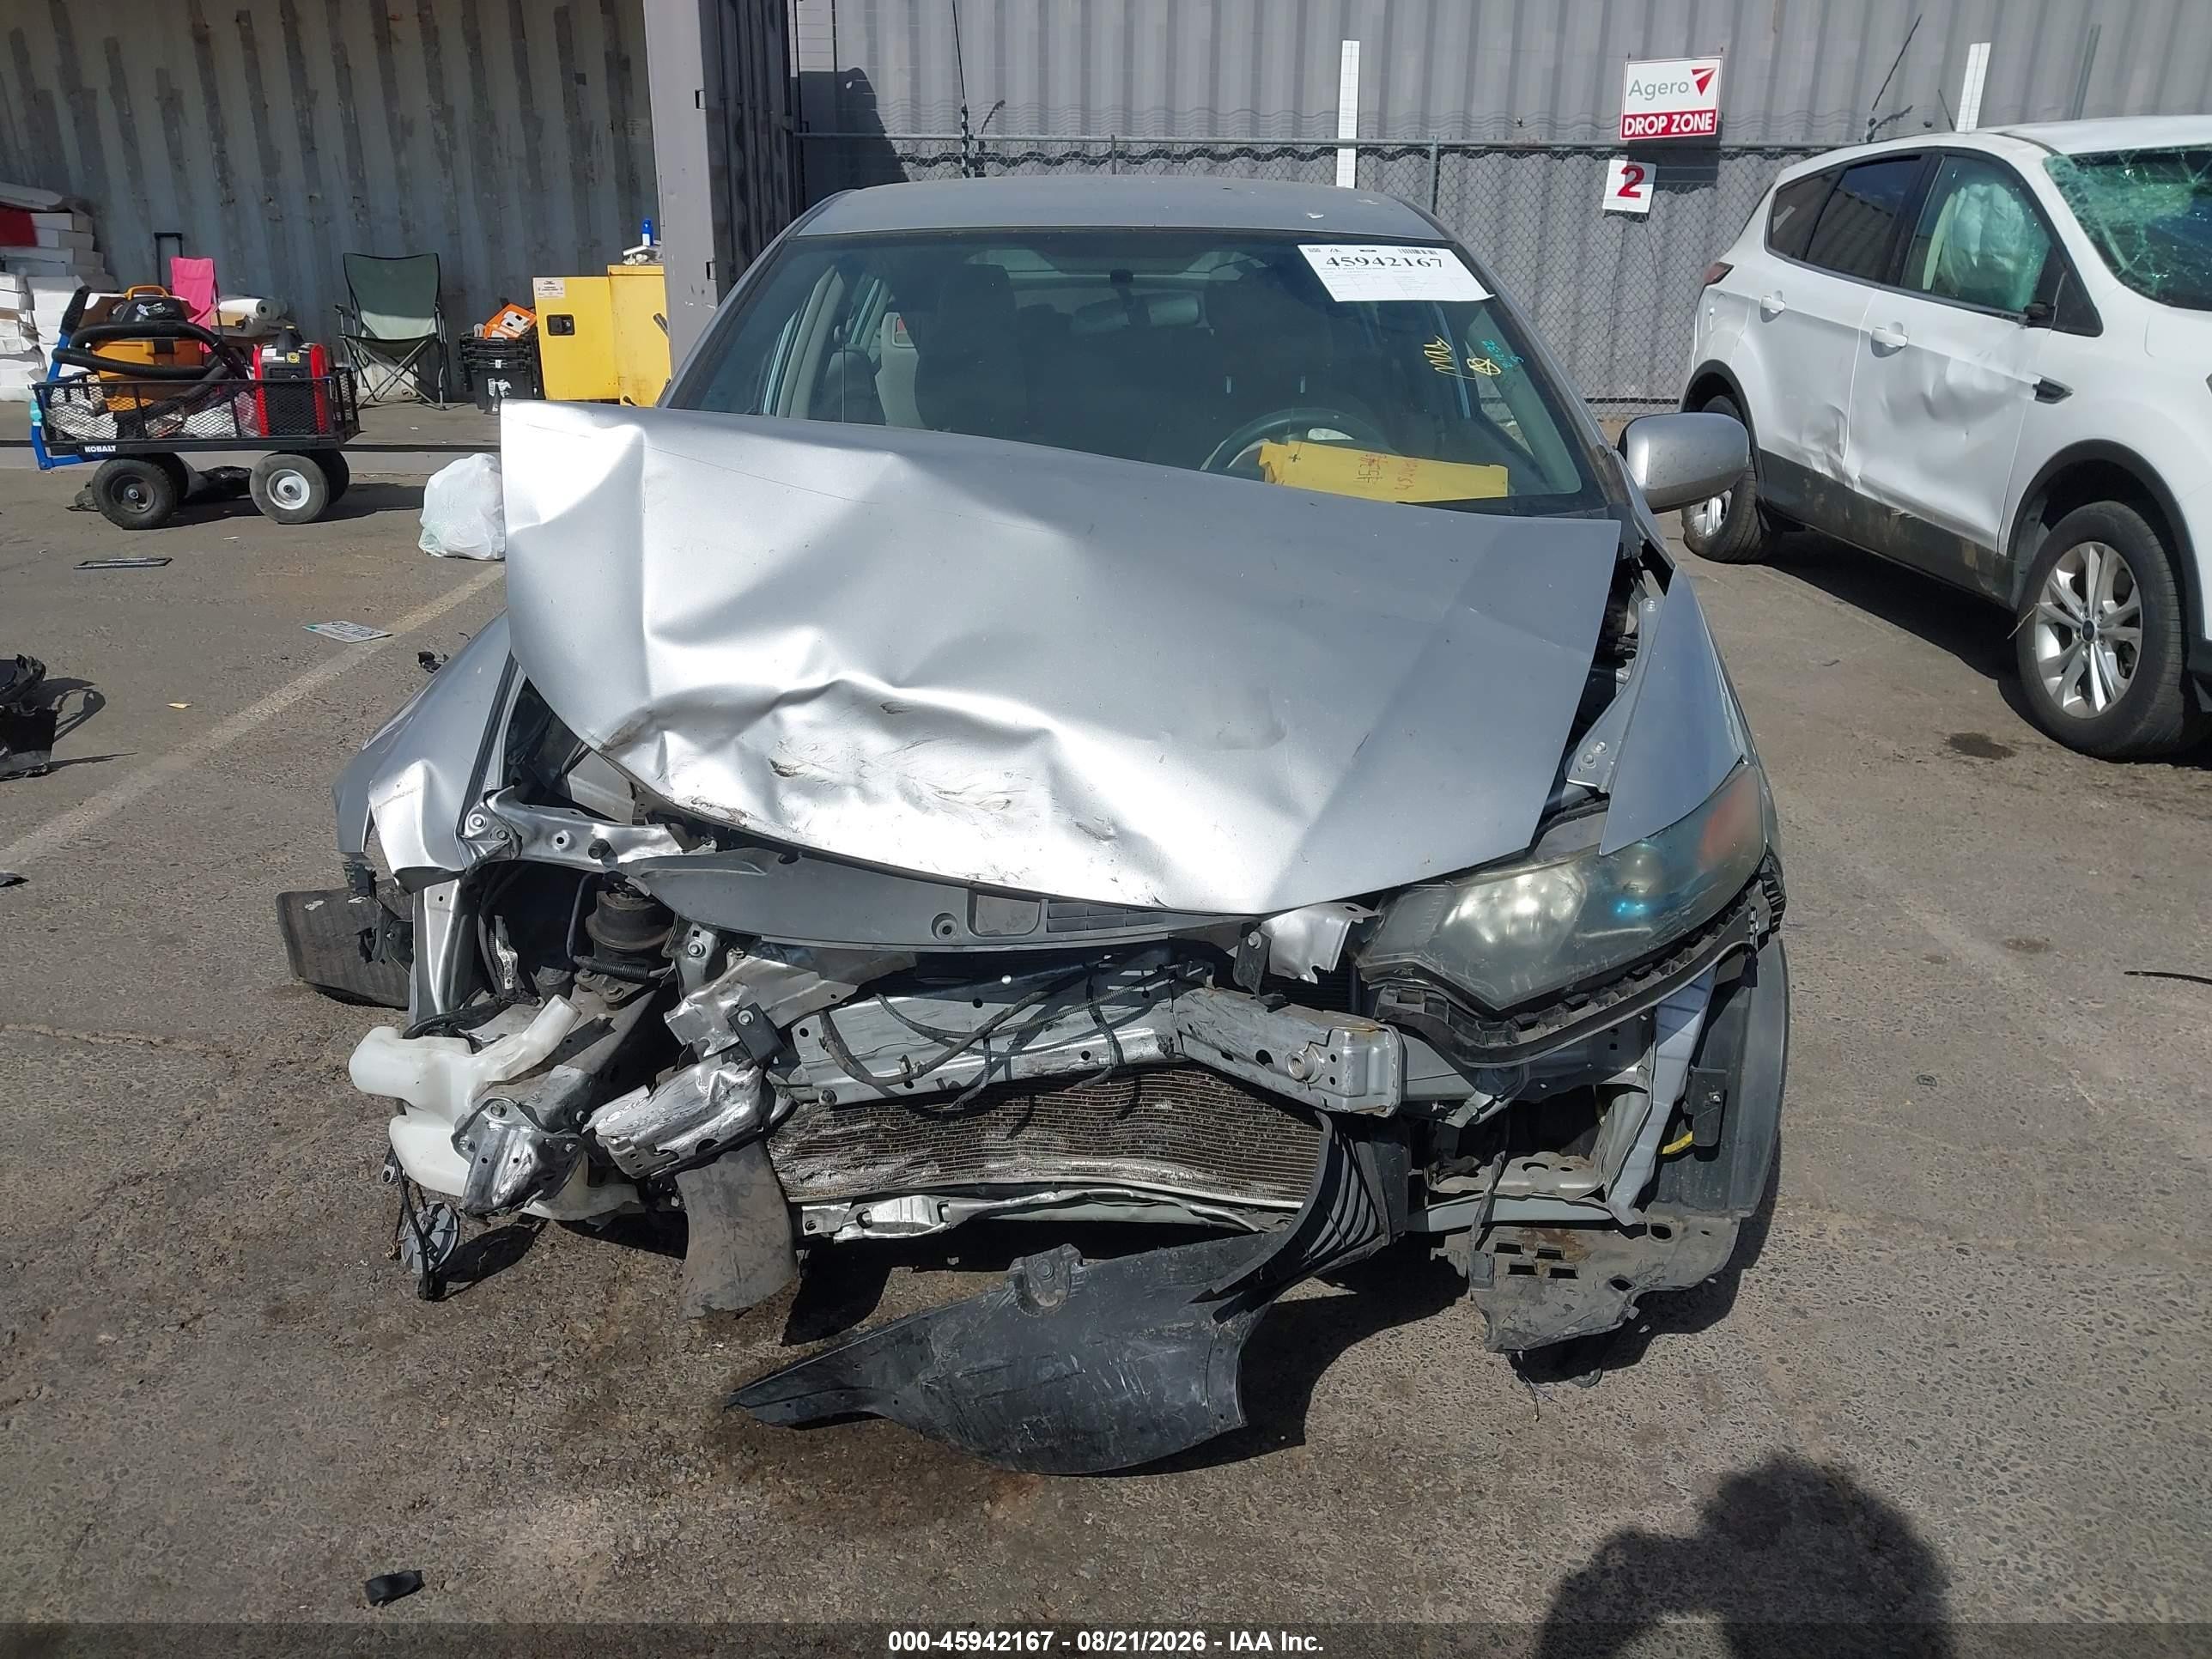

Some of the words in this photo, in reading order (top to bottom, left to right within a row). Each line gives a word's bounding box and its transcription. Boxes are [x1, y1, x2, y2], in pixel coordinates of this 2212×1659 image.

[1629, 80, 1689, 100] Agero
[1625, 116, 1668, 136] DROP
[1671, 112, 1713, 133] ZONE
[1617, 165, 1645, 198] 2
[1326, 256, 1443, 268] 45942167
